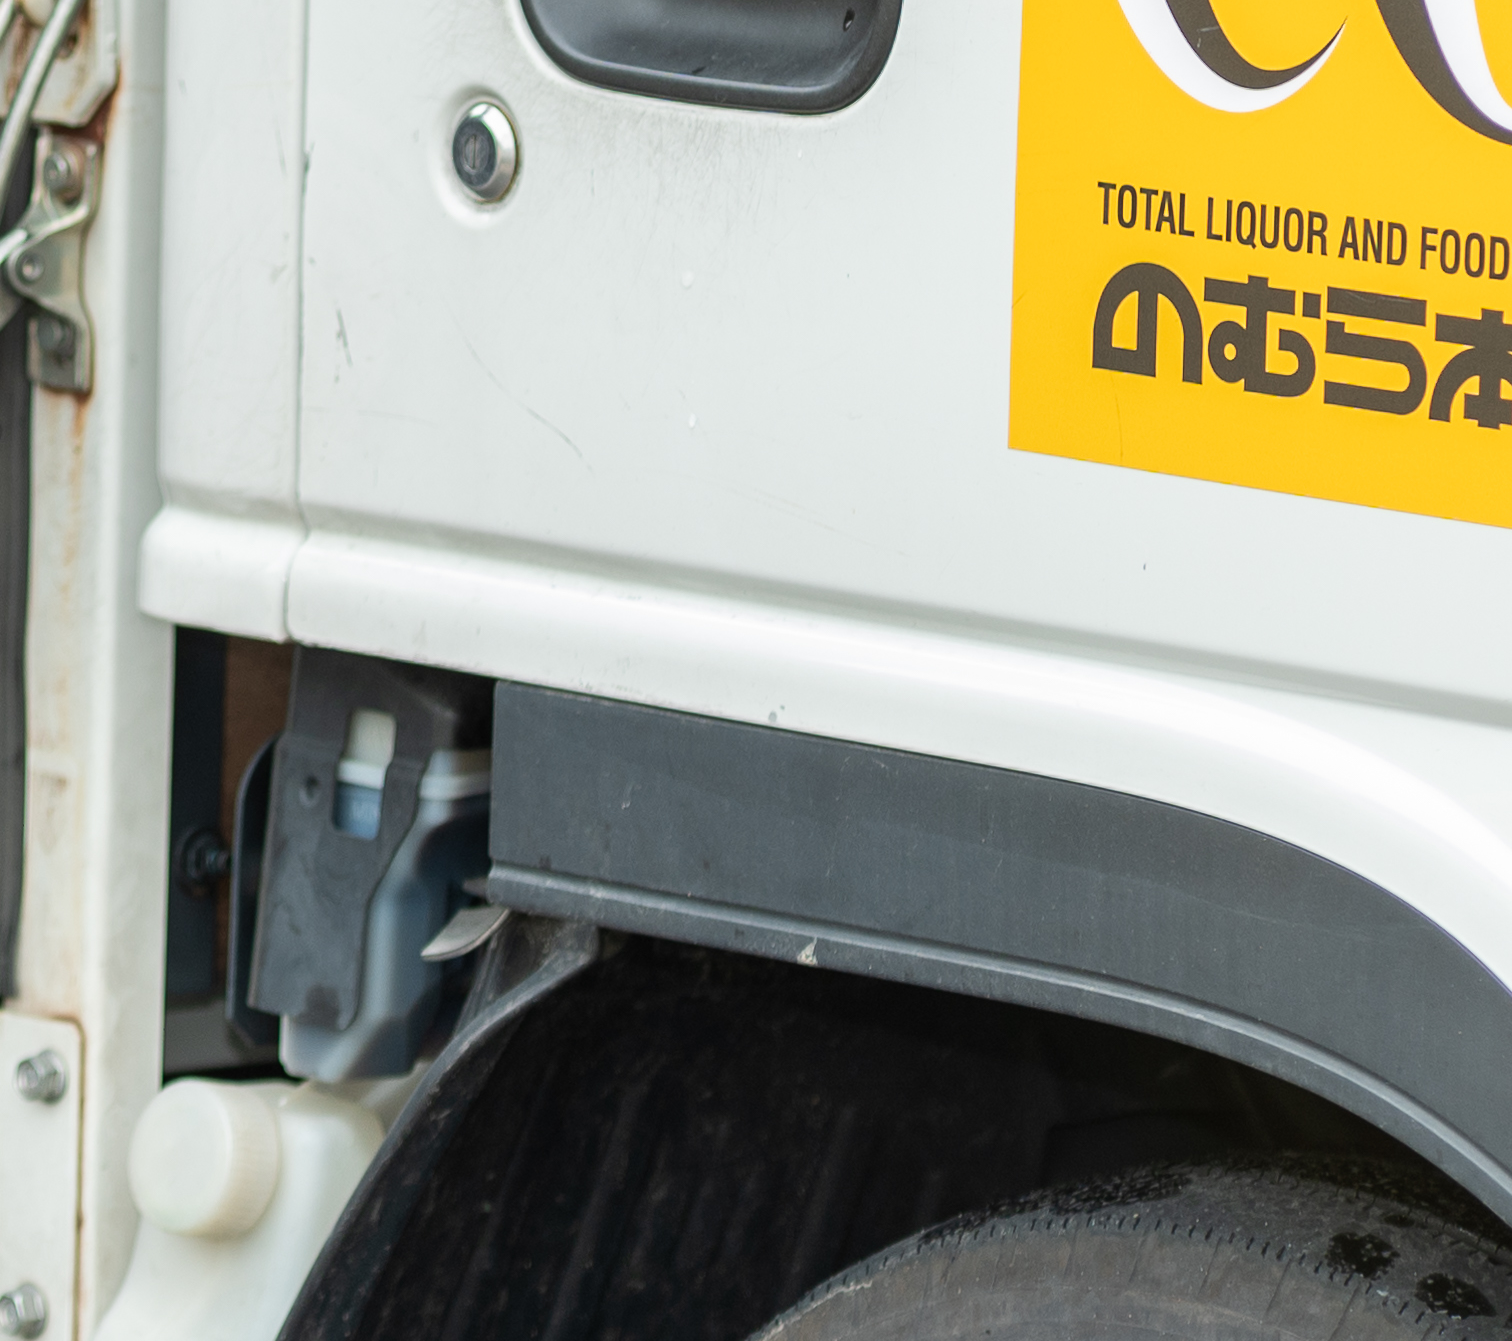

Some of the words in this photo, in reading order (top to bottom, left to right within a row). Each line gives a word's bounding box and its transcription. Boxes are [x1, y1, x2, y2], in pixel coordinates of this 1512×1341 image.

[1097, 180, 1196, 238] TOTAL
[1207, 196, 1328, 257] LIQUOR
[1337, 216, 1408, 268] AND
